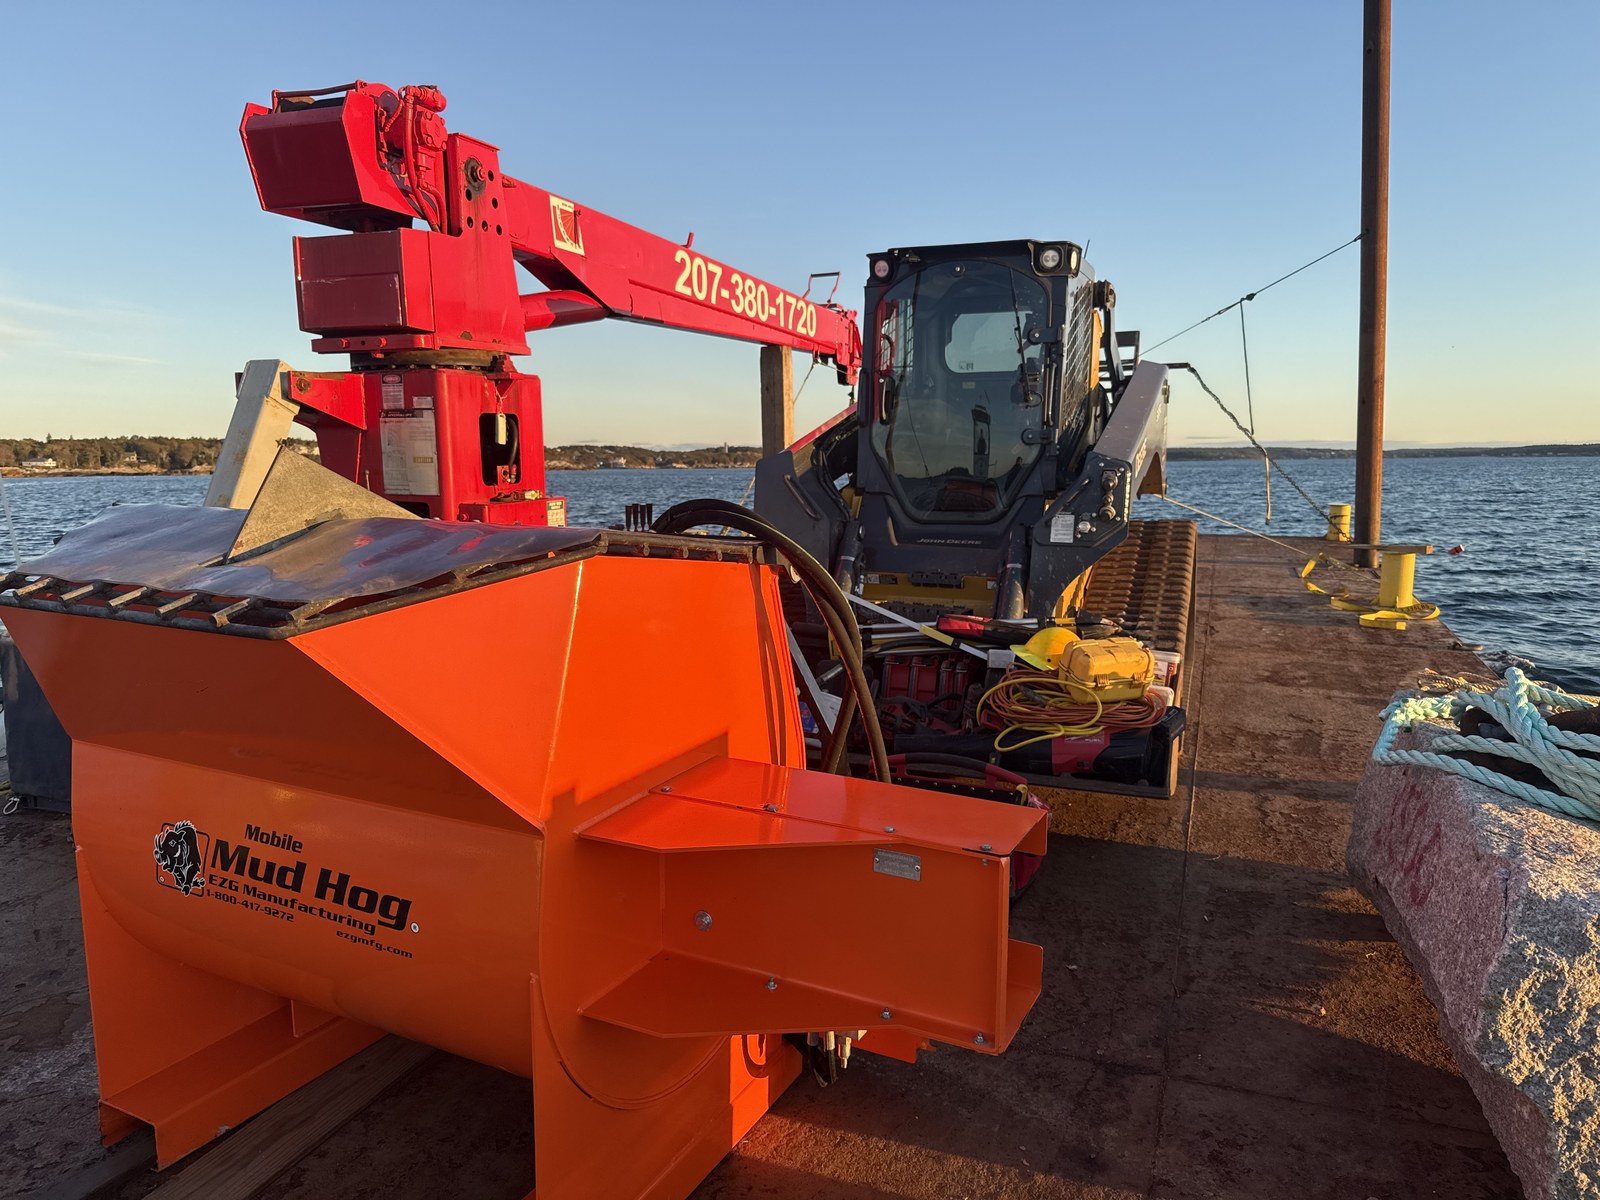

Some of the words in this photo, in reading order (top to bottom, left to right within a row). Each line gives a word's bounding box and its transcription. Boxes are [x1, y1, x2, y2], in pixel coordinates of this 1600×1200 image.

[674, 249, 817, 338] 207-380-1720
[244, 823, 303, 854] Mobile
[206, 888, 295, 923] 1-800-417-9272
[208, 874, 239, 893] EZG
[243, 883, 377, 936] Manufacturing
[210, 838, 307, 894] Mud
[314, 867, 412, 931] Hog
[336, 930, 413, 959] ezgmfg.com
